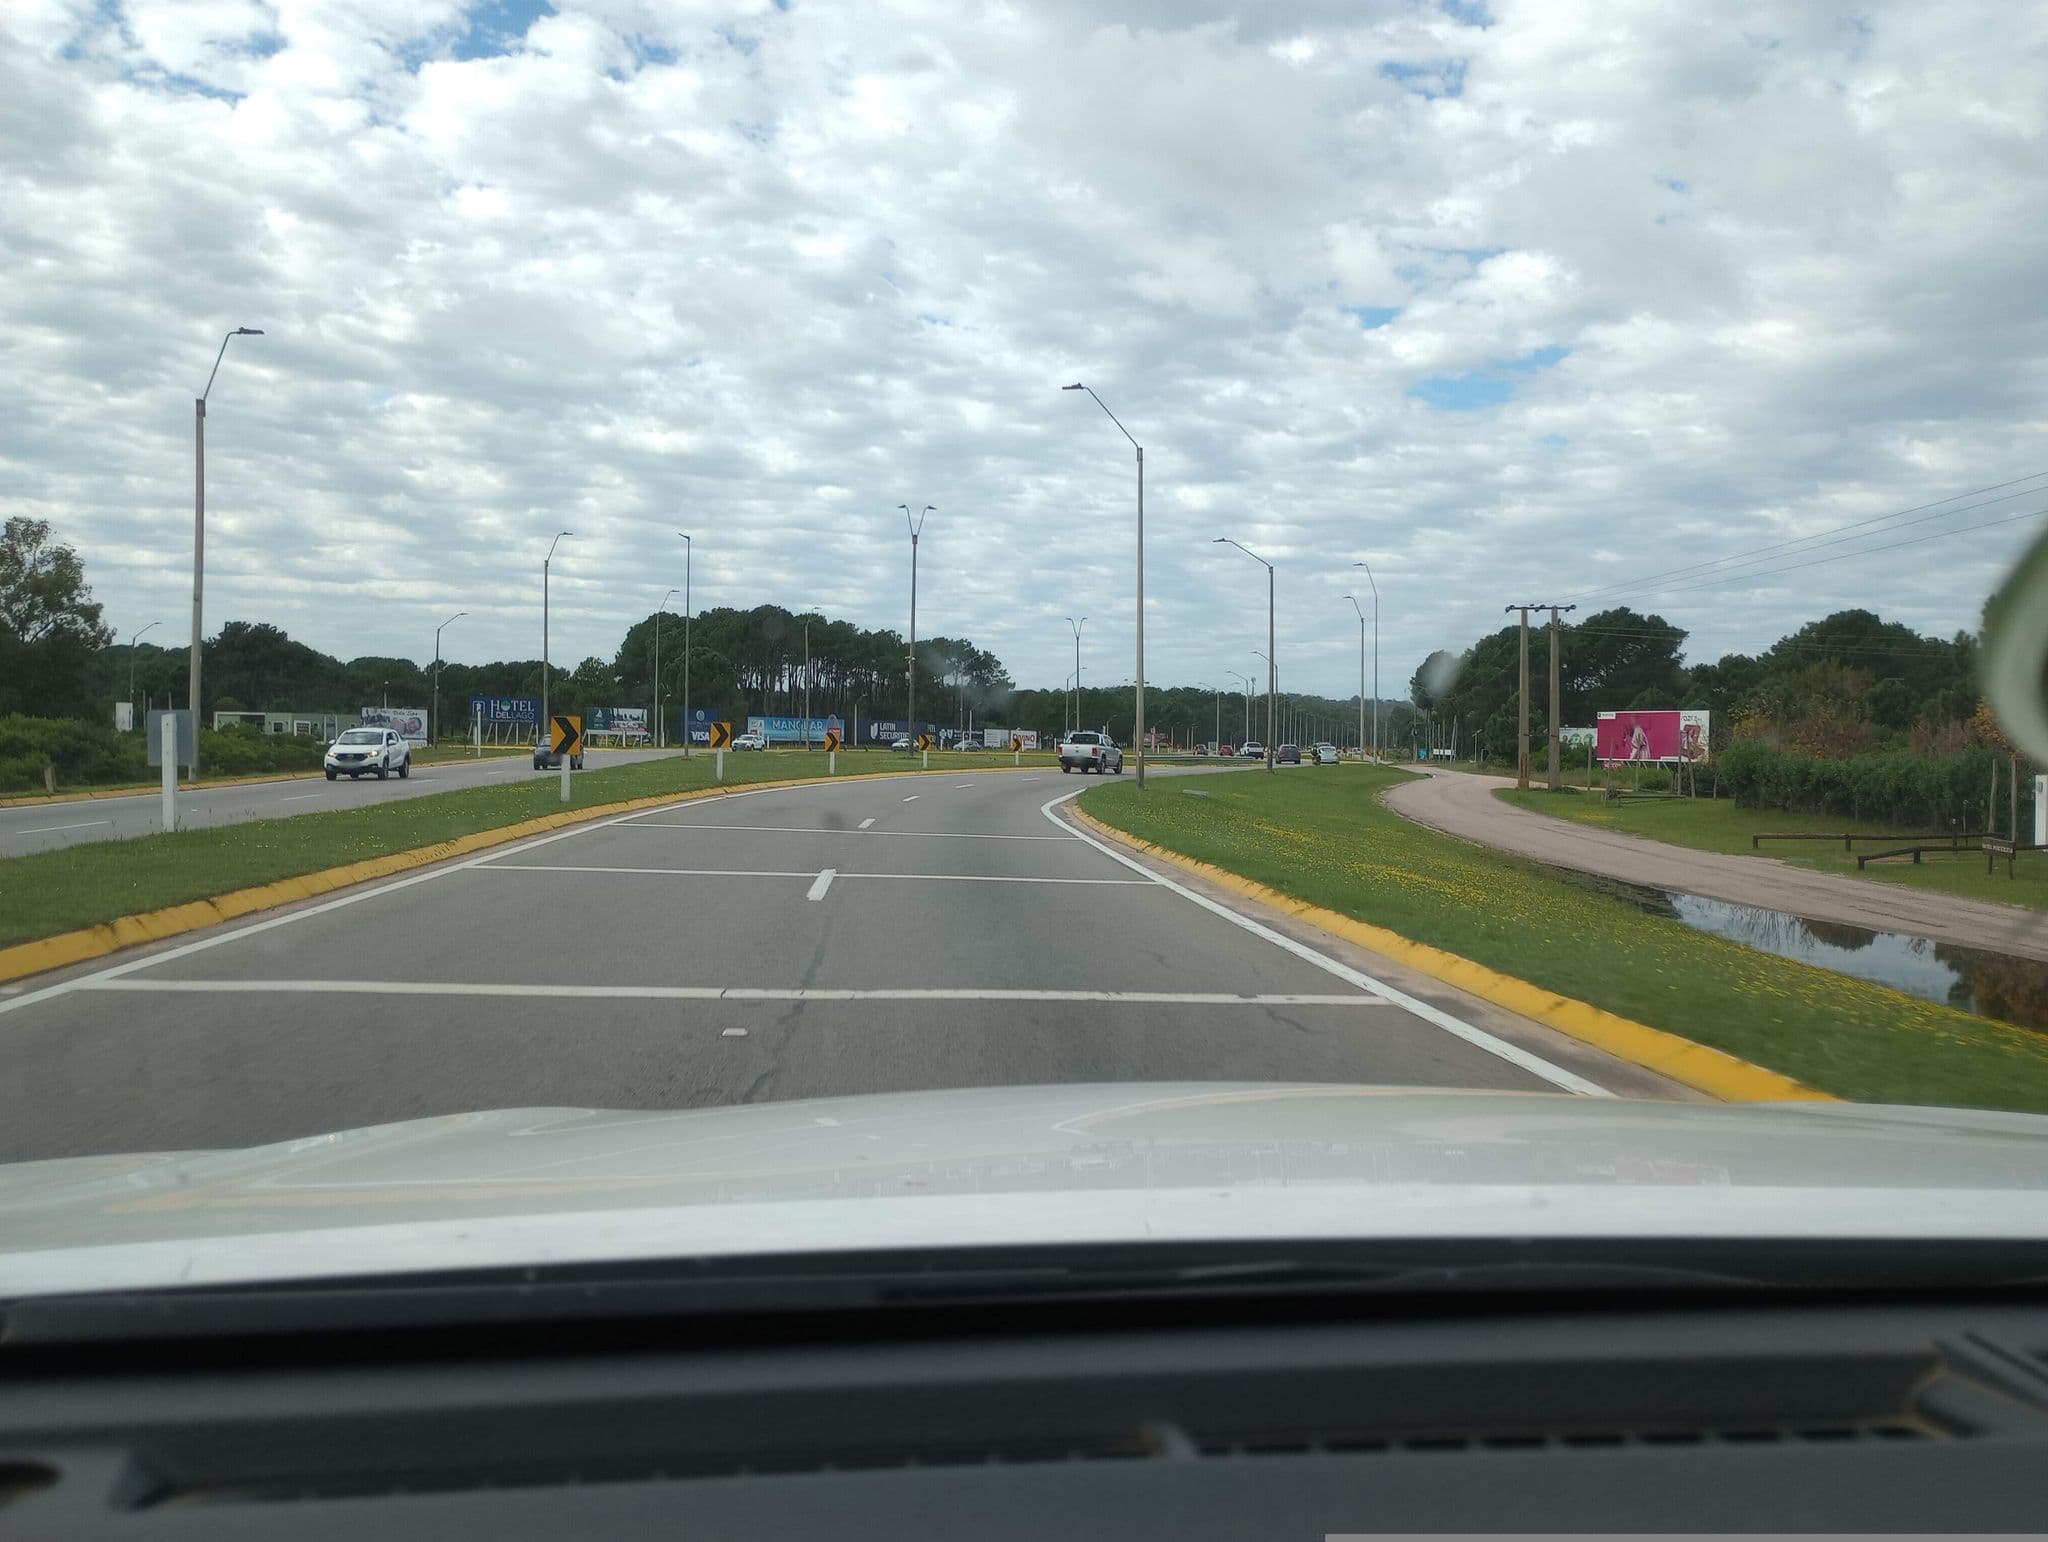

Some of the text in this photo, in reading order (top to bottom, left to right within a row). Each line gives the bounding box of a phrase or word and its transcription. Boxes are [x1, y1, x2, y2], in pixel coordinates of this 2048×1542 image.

[490, 699, 535, 713] HOTEL
[879, 722, 896, 731] LATIN
[690, 731, 709, 741] VISA
